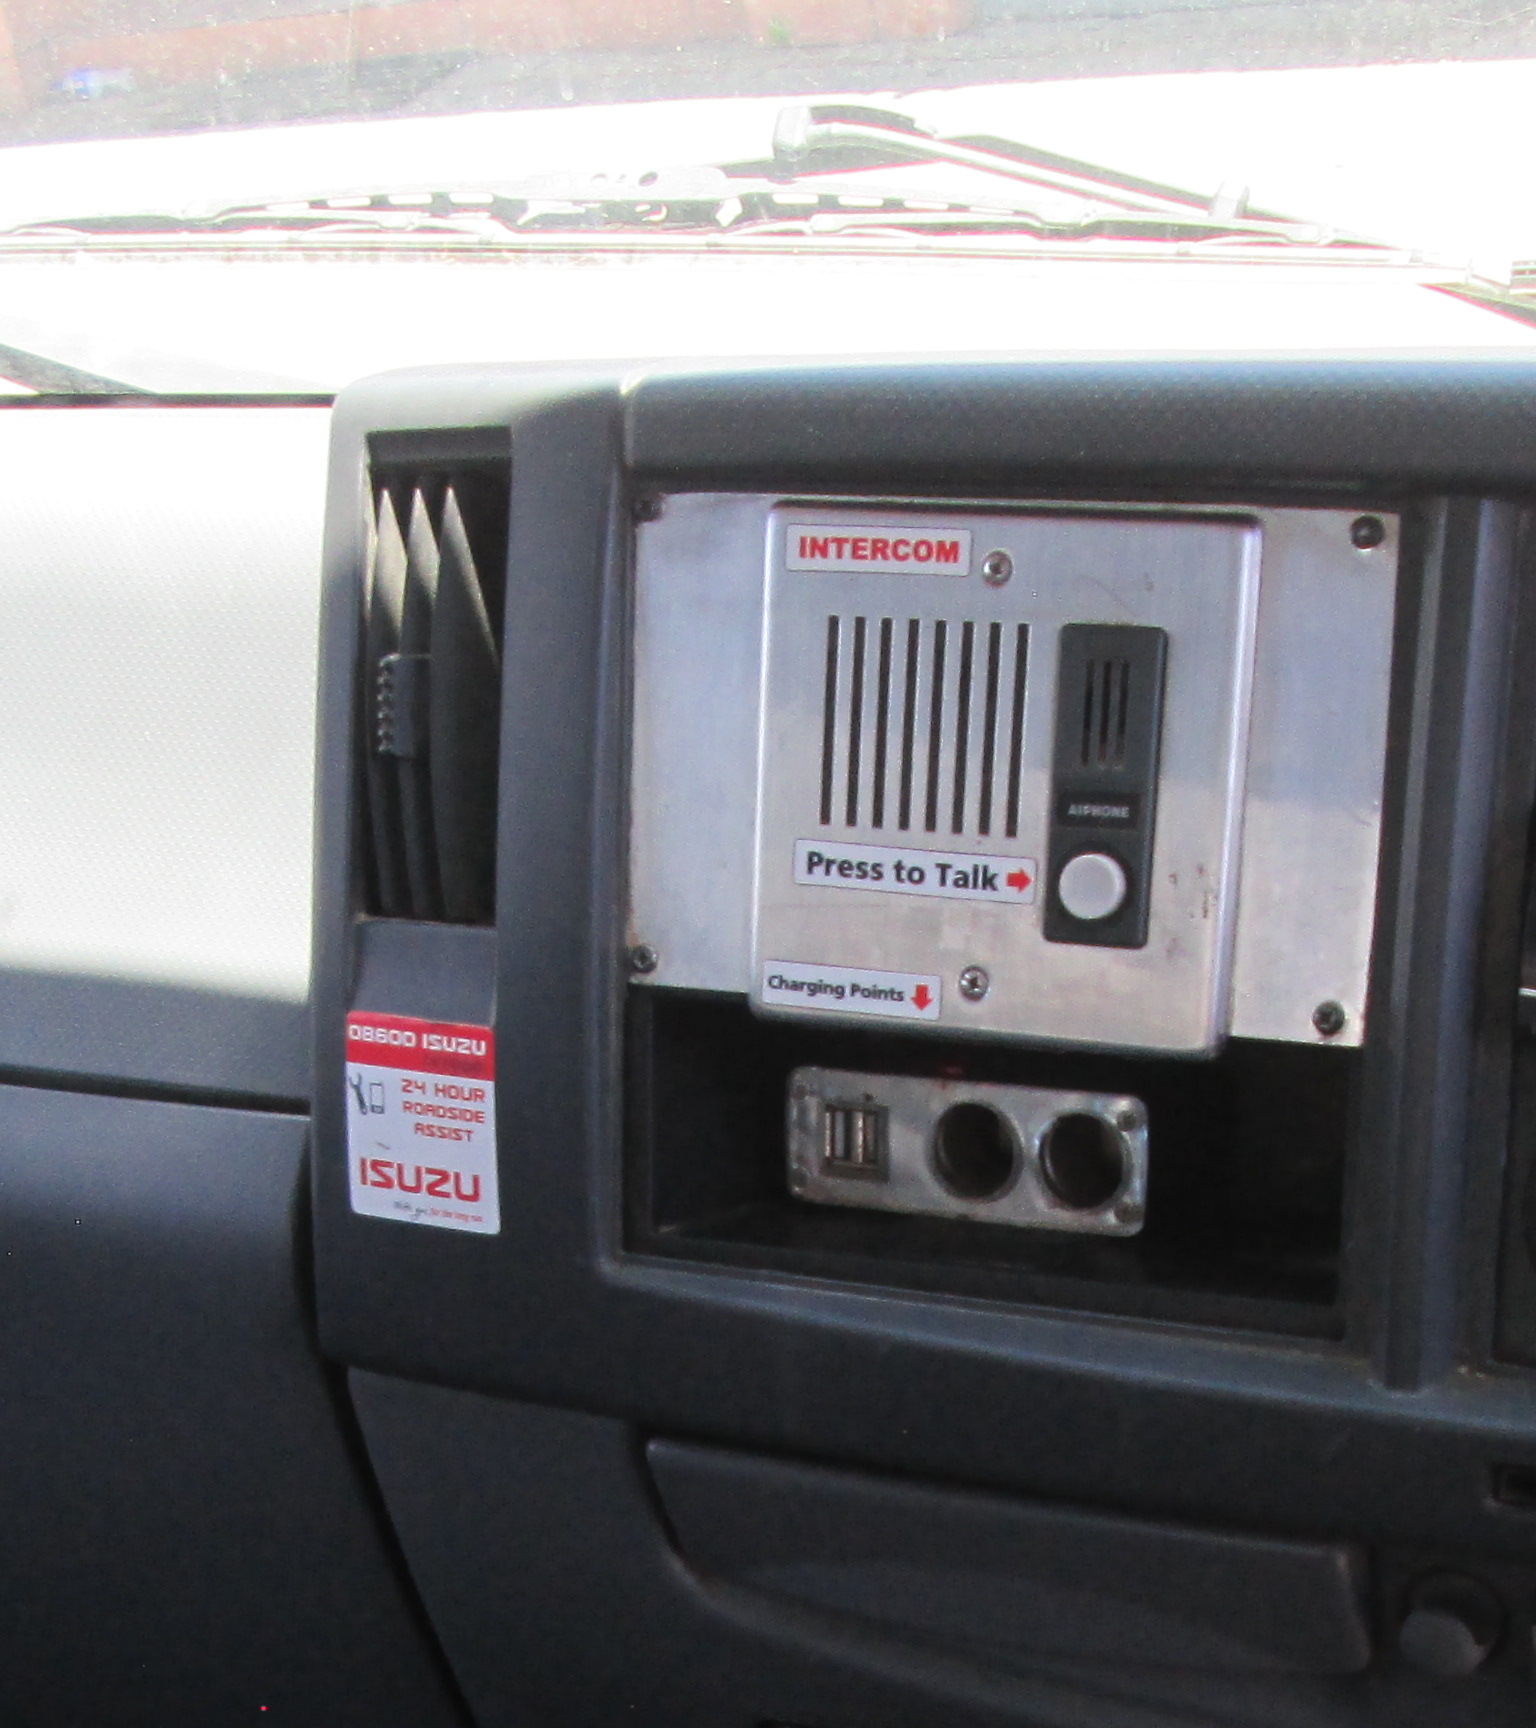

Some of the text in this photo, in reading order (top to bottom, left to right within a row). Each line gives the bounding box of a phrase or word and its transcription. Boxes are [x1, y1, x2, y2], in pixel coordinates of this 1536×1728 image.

[799, 535, 961, 564] INTERCOM
[1067, 802, 1131, 819] AIPHONE
[806, 850, 1000, 892] Press to Talk
[767, 974, 905, 1002] Charging Points
[349, 1024, 486, 1056] 08600 ISUZU
[401, 1078, 485, 1102] 24 HOUR
[402, 1101, 486, 1124] ROADSIDE
[414, 1122, 474, 1142] ASSIST
[359, 1157, 481, 1203] ISUZU
